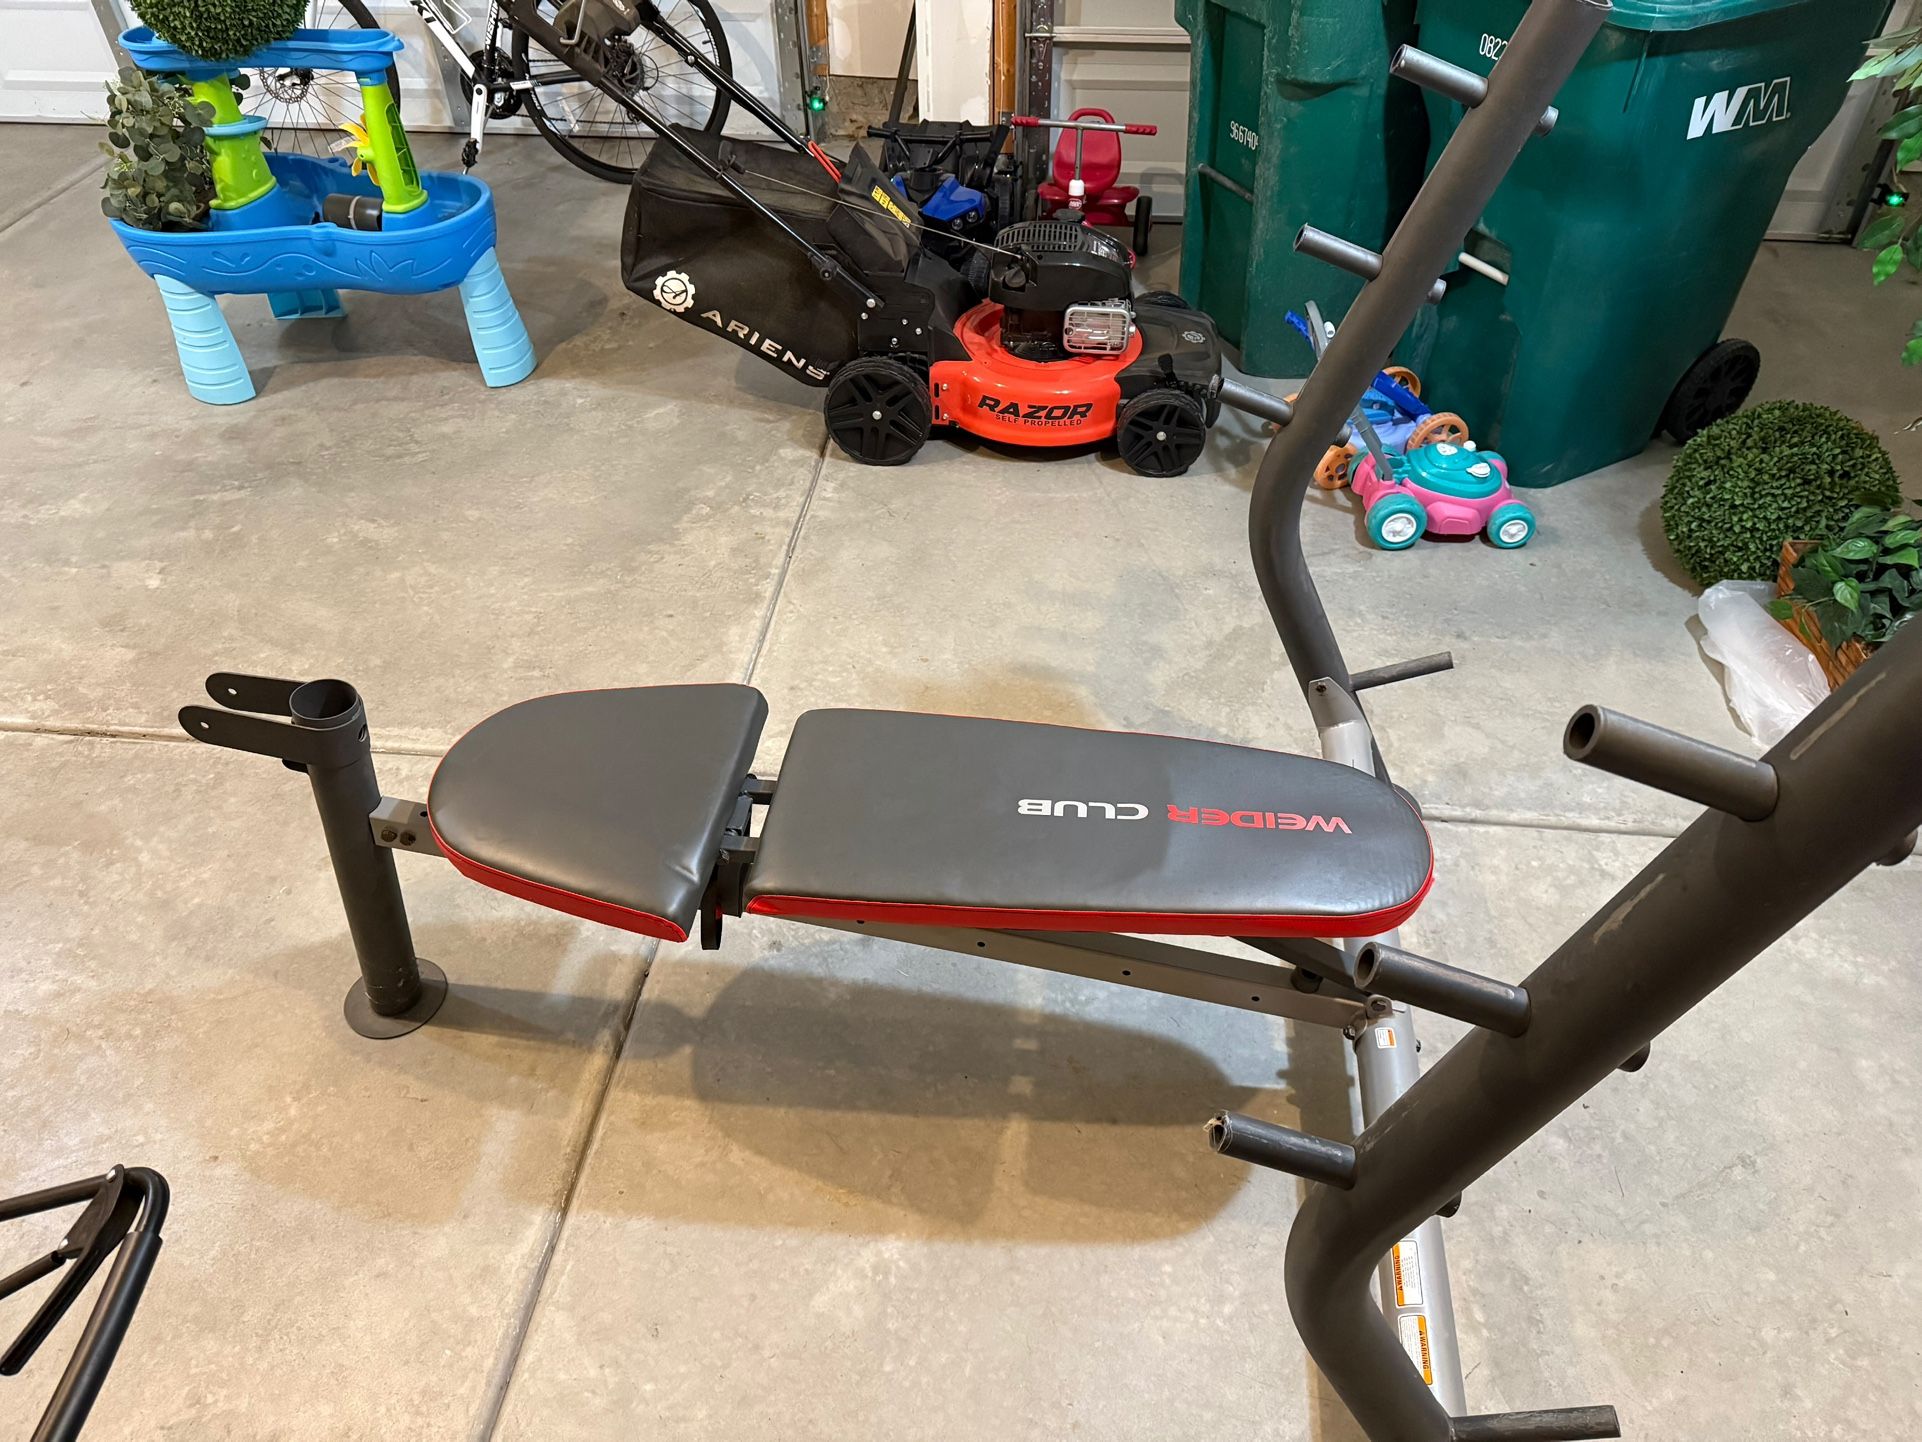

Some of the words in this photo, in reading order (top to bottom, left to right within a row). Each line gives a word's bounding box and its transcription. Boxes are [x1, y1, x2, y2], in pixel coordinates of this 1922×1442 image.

[1479, 33, 1508, 61] 082
[1687, 77, 1791, 140] WM
[701, 310, 829, 380] ARIENS
[978, 395, 1093, 420] RAZOR
[996, 414, 1019, 424] SELF
[1024, 418, 1082, 427] PROPELLED
[1017, 799, 1149, 820] CLUB
[1167, 804, 1352, 834] WEIDER
[1394, 1255, 1403, 1286] WARNING
[1419, 1336, 1430, 1370] WARNING
